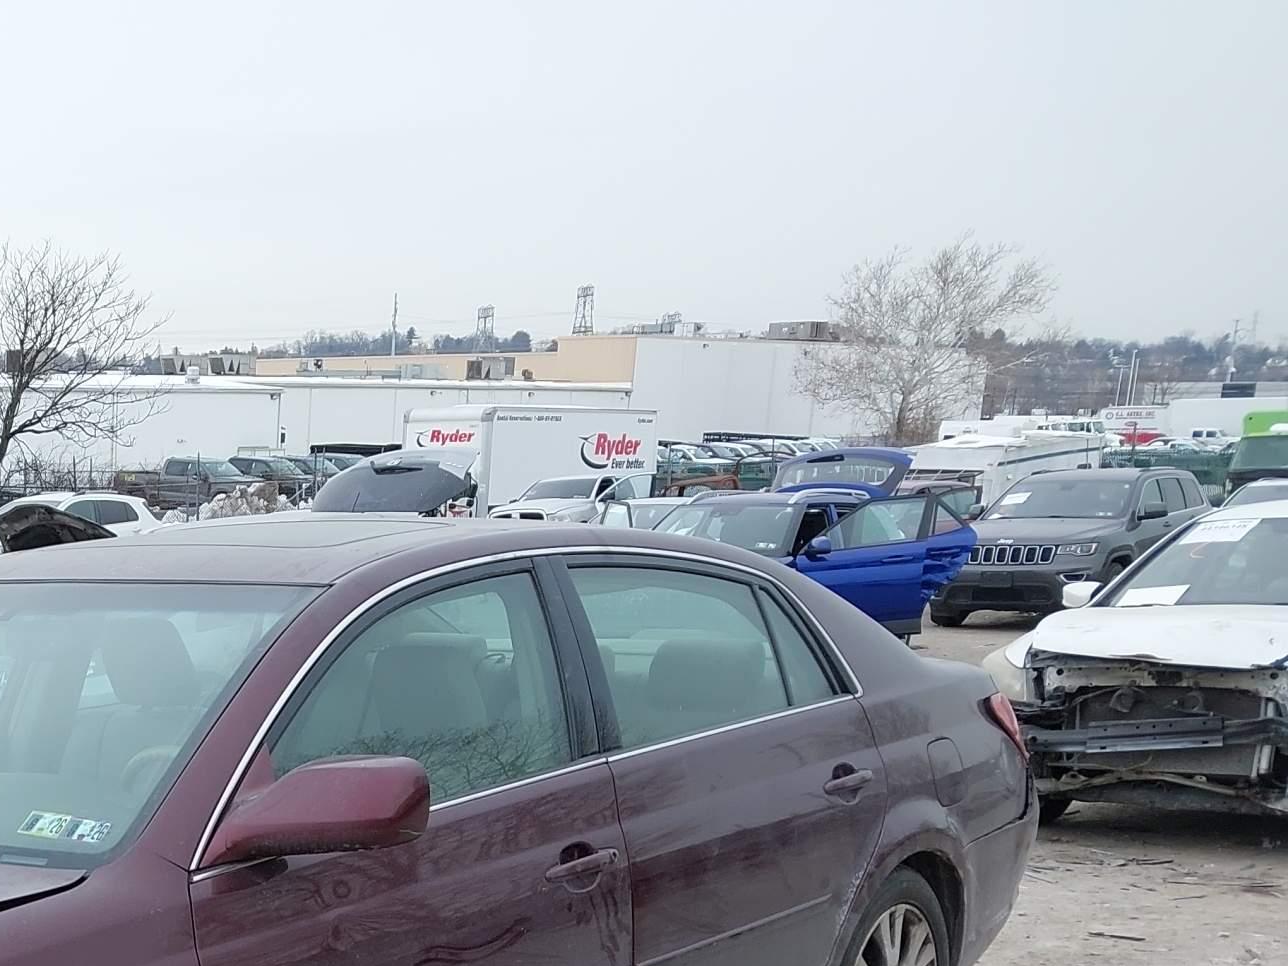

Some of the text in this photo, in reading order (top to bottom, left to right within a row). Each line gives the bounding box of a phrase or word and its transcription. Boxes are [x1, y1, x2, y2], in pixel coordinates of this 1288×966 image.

[429, 429, 475, 446] Ryder
[594, 433, 642, 461] Ryder
[611, 458, 625, 469] Ever
